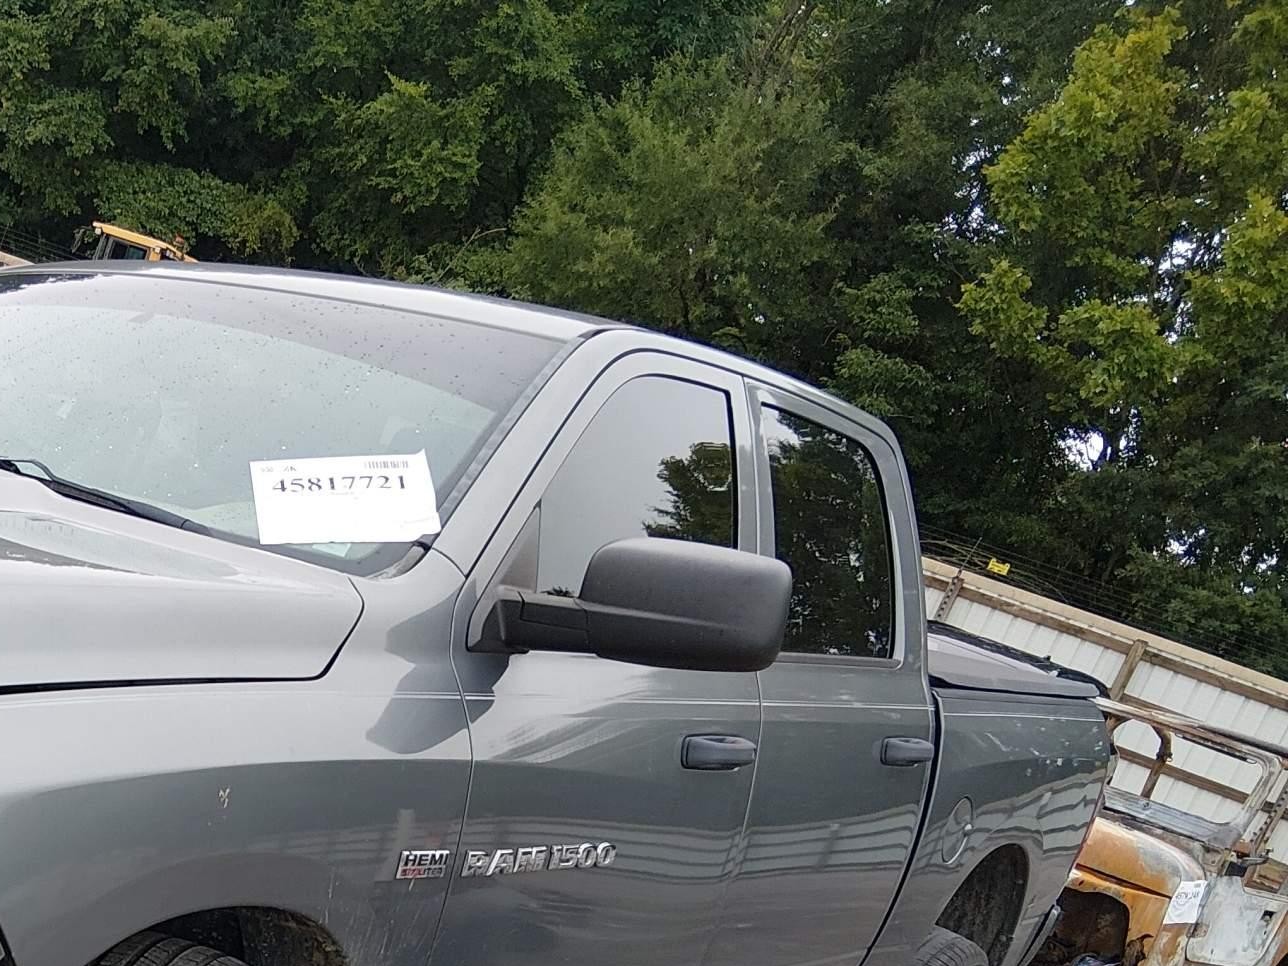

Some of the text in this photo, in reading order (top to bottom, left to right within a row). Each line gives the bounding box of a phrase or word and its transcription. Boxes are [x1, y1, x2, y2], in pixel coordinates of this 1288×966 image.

[272, 475, 406, 492] 45817721
[402, 852, 449, 866] HEMI
[461, 841, 617, 877] RAM 1500
